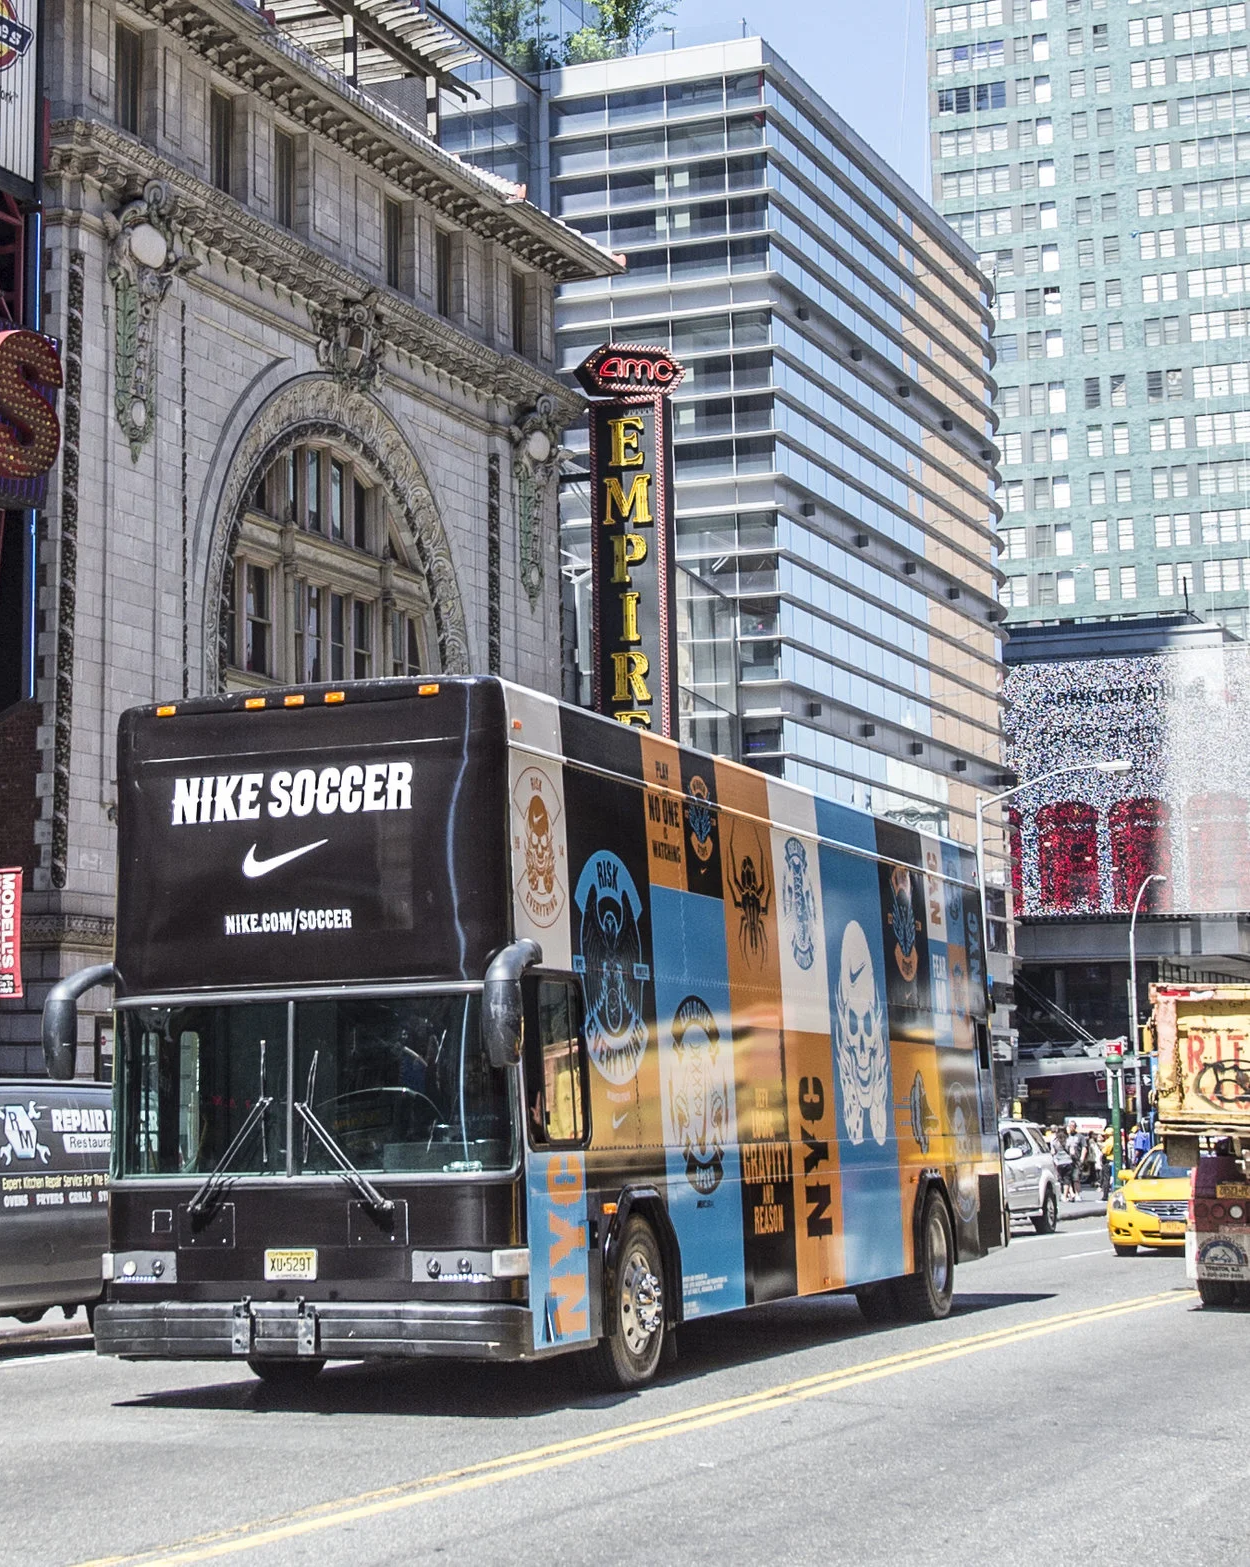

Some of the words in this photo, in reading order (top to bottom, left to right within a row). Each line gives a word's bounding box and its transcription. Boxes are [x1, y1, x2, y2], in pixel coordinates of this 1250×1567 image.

[655, 761, 668, 780] PLAY
[172, 772, 263, 825] NIKE
[268, 761, 413, 817] SOCCER
[648, 793, 661, 823] NO
[662, 798, 680, 828] ONE
[652, 840, 681, 863] WATCHING
[596, 861, 618, 892] RISK
[526, 892, 558, 917] EVERYTHING
[0, 873, 16, 969] MODELL'S
[225, 908, 352, 936] NIKE.COM/SOCCER
[967, 912, 981, 983] NYC
[586, 1021, 646, 1077] EVERYTHING
[52, 1109, 105, 1132] REPAIR
[20, 1132, 34, 1149] M
[743, 1143, 789, 1184] GRAVITY
[799, 1076, 833, 1240] NYC
[2, 1177, 22, 1190] Expert
[63, 1174, 82, 1187] Service
[84, 1174, 93, 1186] For
[93, 1173, 103, 1186] The
[69, 1191, 92, 1203] GRILLS
[762, 1184, 774, 1204] AND
[754, 1204, 784, 1235] REASON
[546, 1152, 588, 1335] NYC
